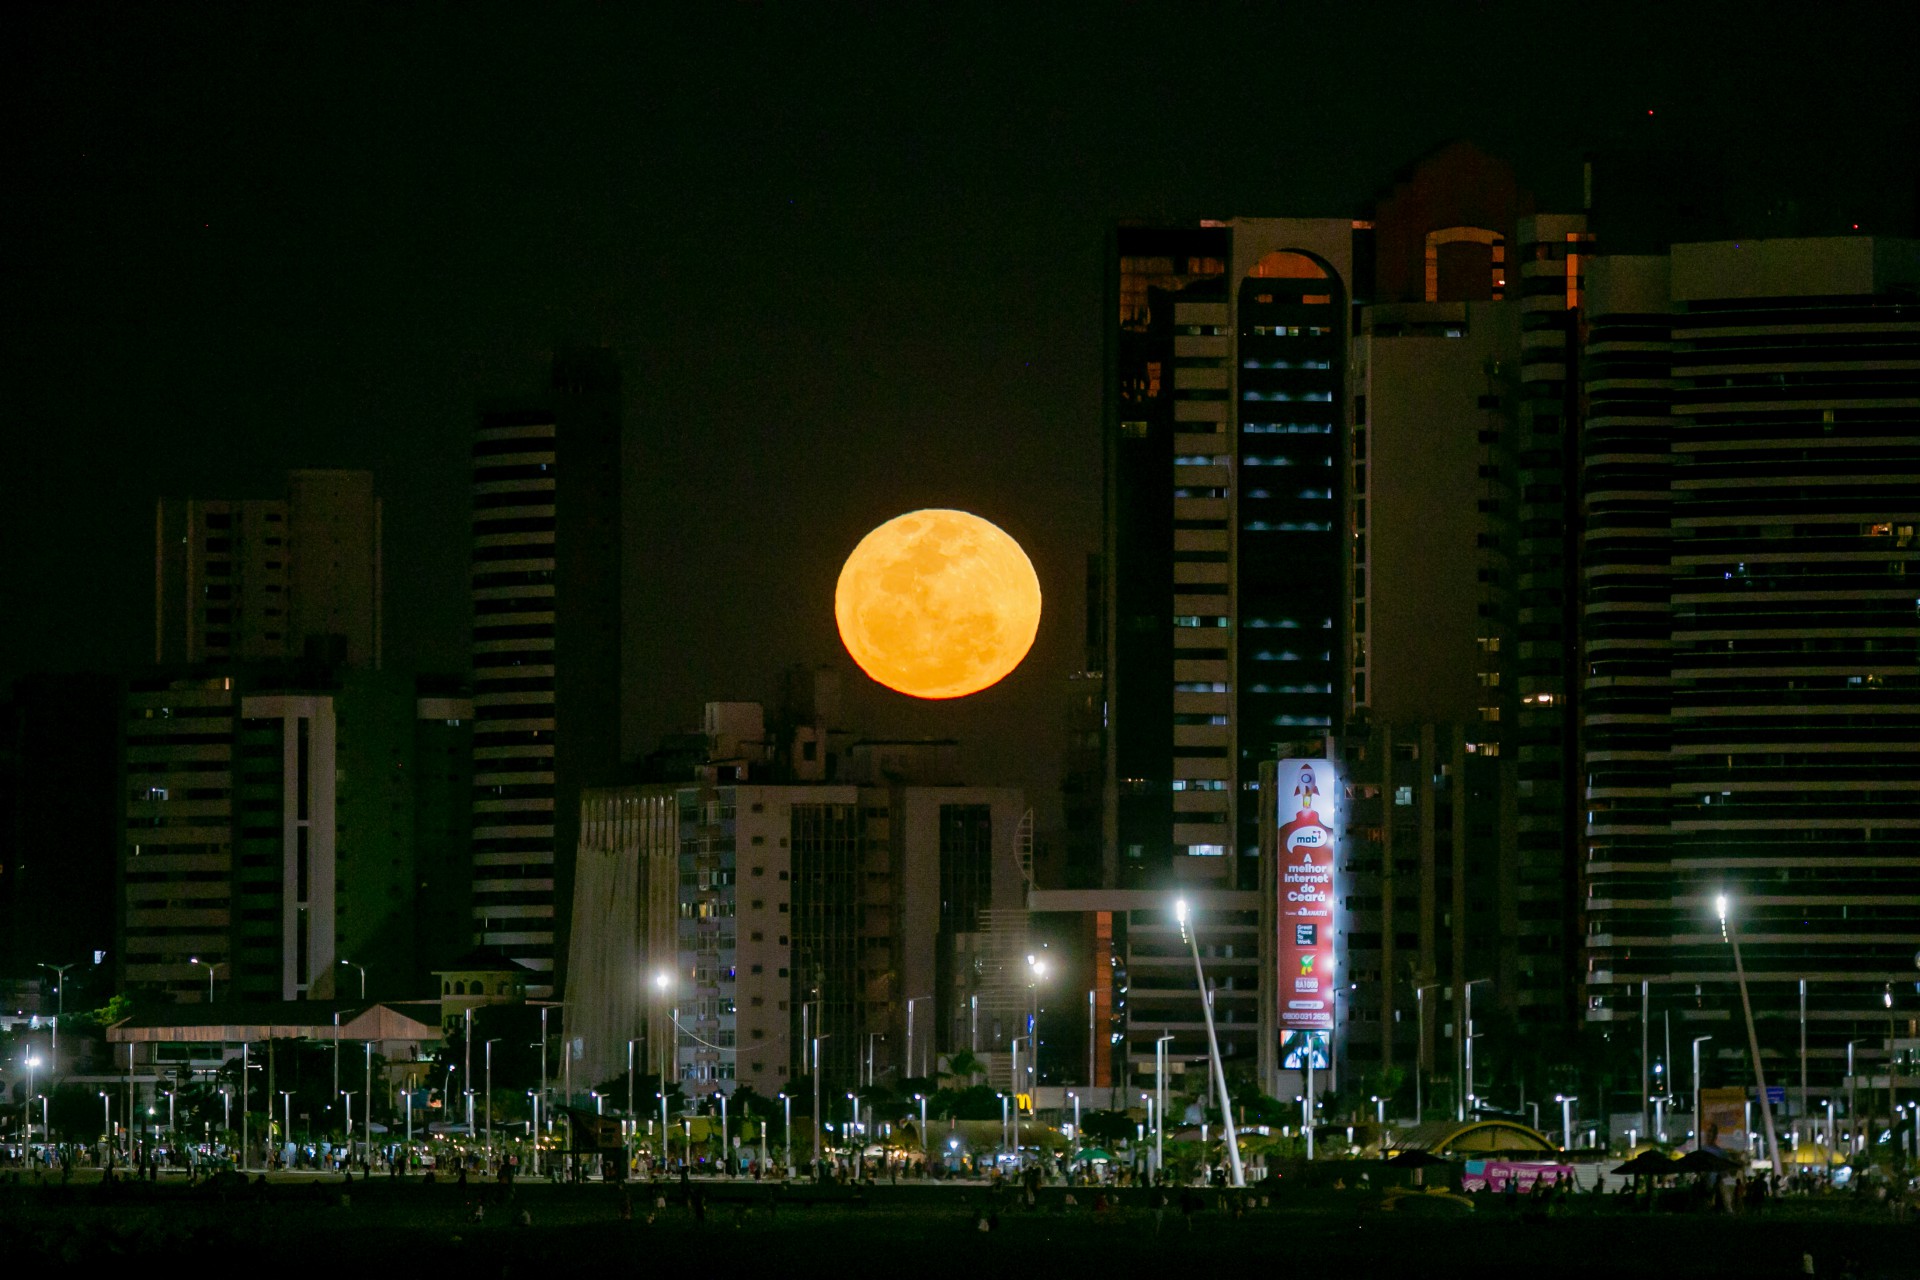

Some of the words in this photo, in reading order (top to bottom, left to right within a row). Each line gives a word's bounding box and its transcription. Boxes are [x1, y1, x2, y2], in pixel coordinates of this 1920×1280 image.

[1303, 853, 1313, 863] A
[1288, 863, 1328, 873] melhor
[1300, 883, 1316, 893] do
[1287, 890, 1326, 902] Ceará
[1491, 1168, 1508, 1177] Em
